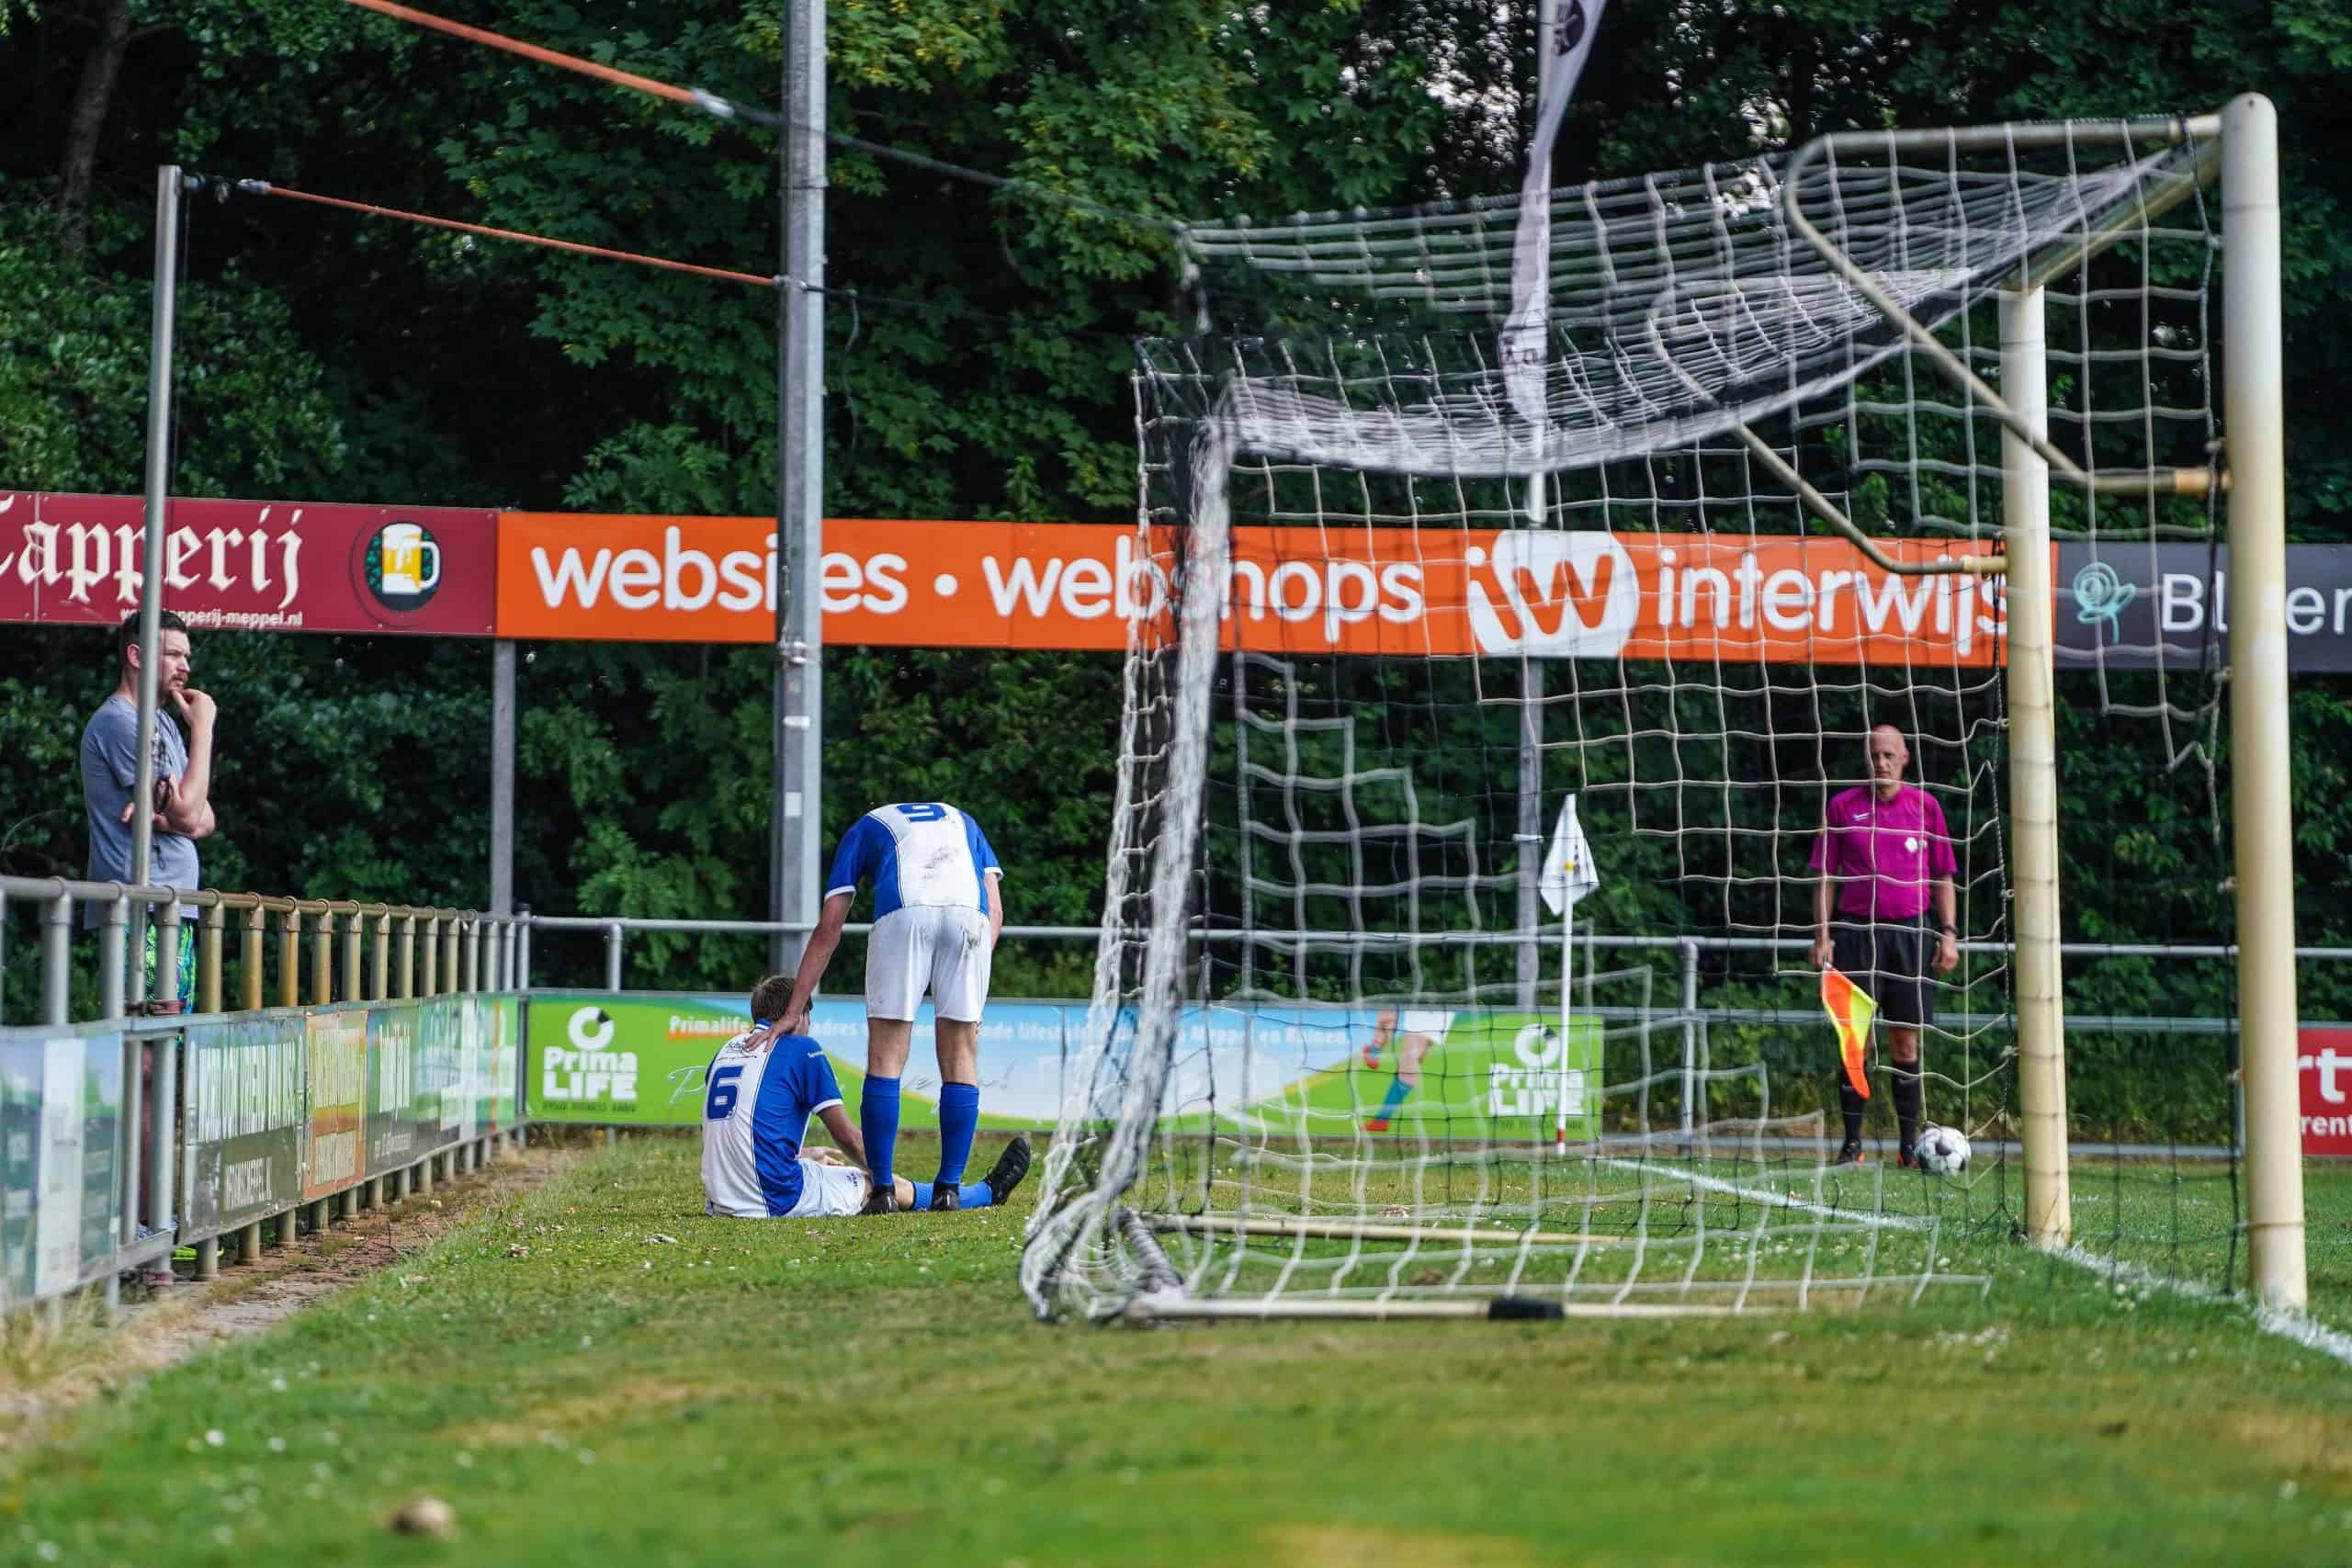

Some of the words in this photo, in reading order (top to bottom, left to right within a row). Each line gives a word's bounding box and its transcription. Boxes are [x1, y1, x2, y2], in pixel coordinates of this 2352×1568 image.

[0, 494, 302, 609] apperij
[530, 525, 909, 614] websies
[982, 535, 1424, 643] webhops
[1657, 547, 2007, 657] interwijs
[897, 801, 947, 823] 9
[543, 1046, 638, 1072] Prima
[543, 1071, 638, 1100] LIFE
[1489, 1063, 1584, 1089] Prima
[707, 1066, 743, 1120] 6
[1488, 1089, 1584, 1117] LIFE
